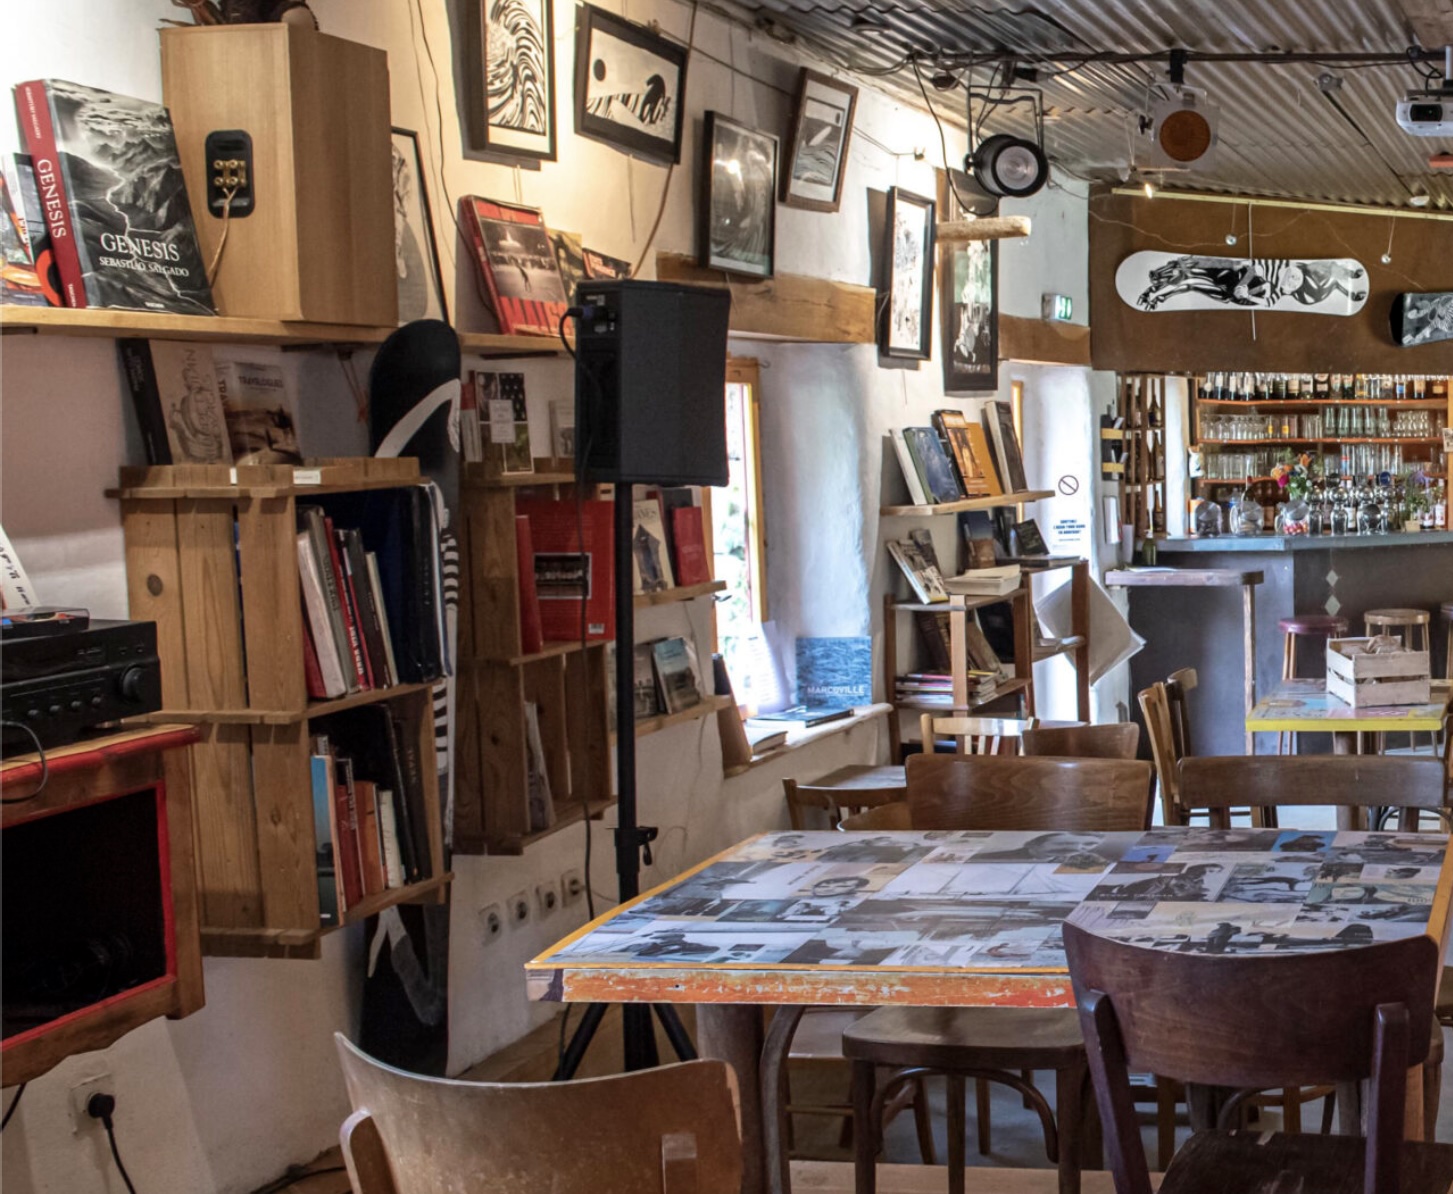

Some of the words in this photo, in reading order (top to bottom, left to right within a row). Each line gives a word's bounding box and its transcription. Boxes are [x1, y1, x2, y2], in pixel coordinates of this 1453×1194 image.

[36, 158, 67, 239] GENESIS
[101, 232, 180, 262] GENESIS
[148, 262, 190, 278] SALGADO
[807, 685, 865, 694] MARCOVILLE
